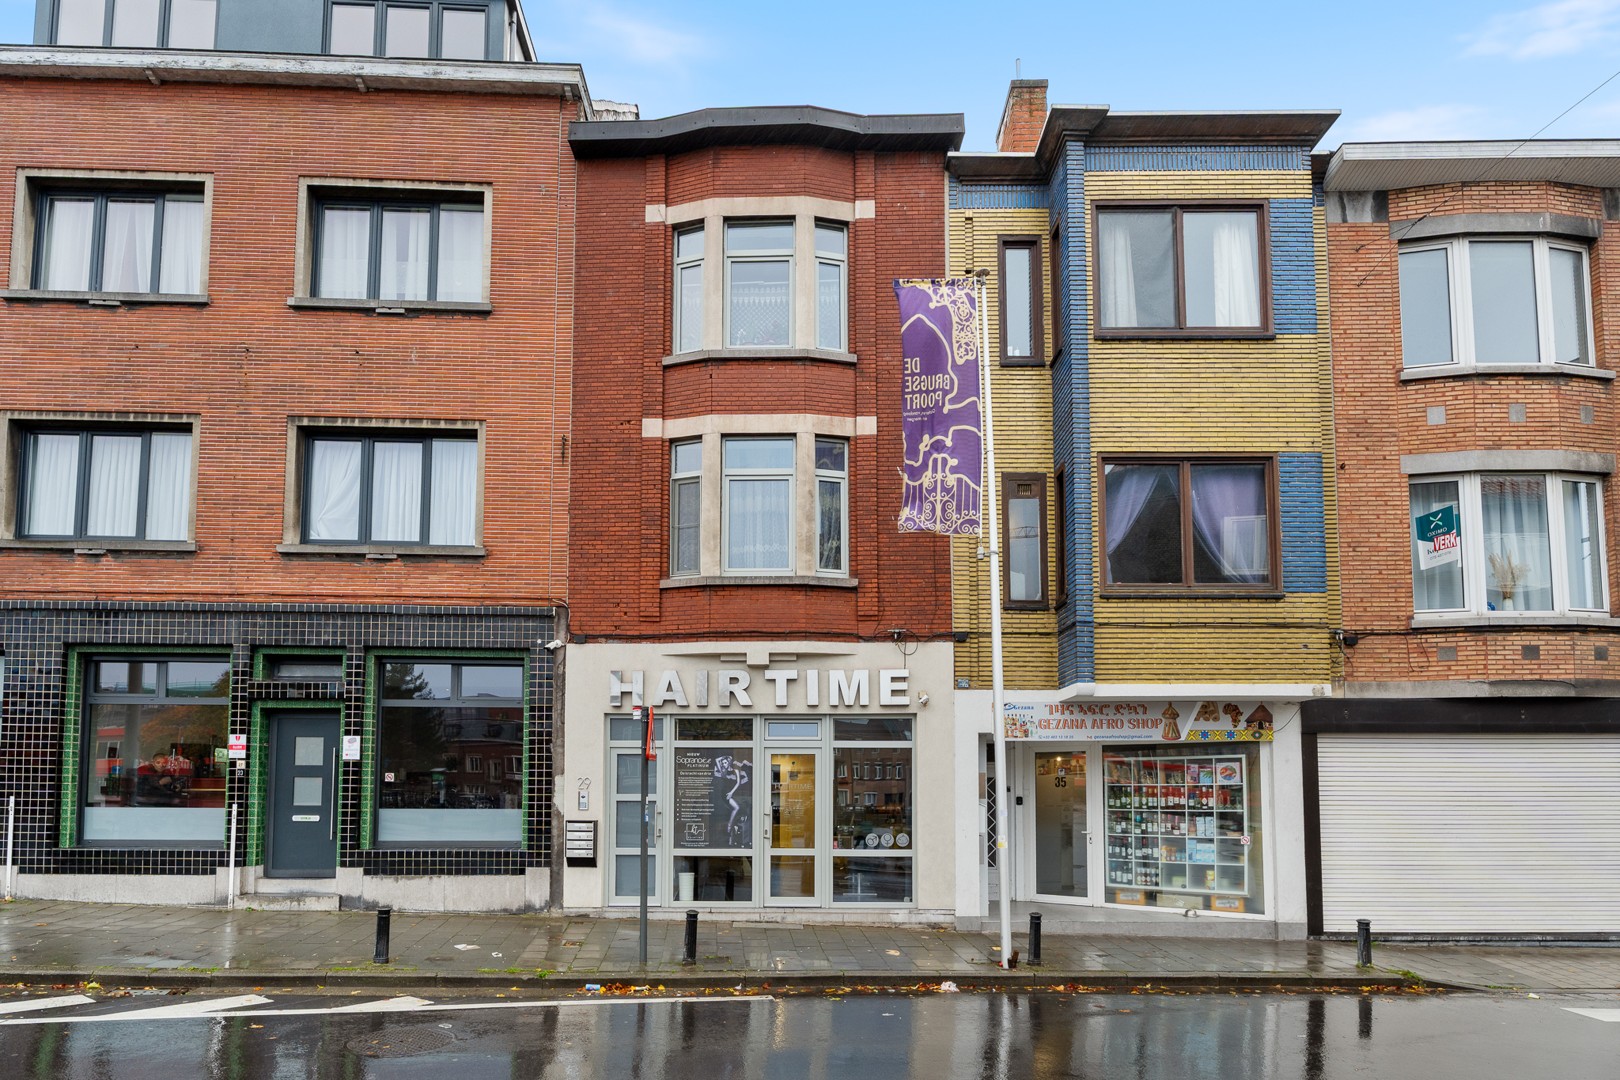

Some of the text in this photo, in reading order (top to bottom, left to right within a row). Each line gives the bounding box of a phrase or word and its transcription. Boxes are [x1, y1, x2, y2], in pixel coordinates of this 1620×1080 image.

[1427, 527, 1448, 537] OXIMO
[1434, 532, 1457, 550] VERK
[1038, 718, 1163, 730] GEZANA AFRO SHOP
[577, 777, 592, 791] 29
[1055, 776, 1067, 788] 35
